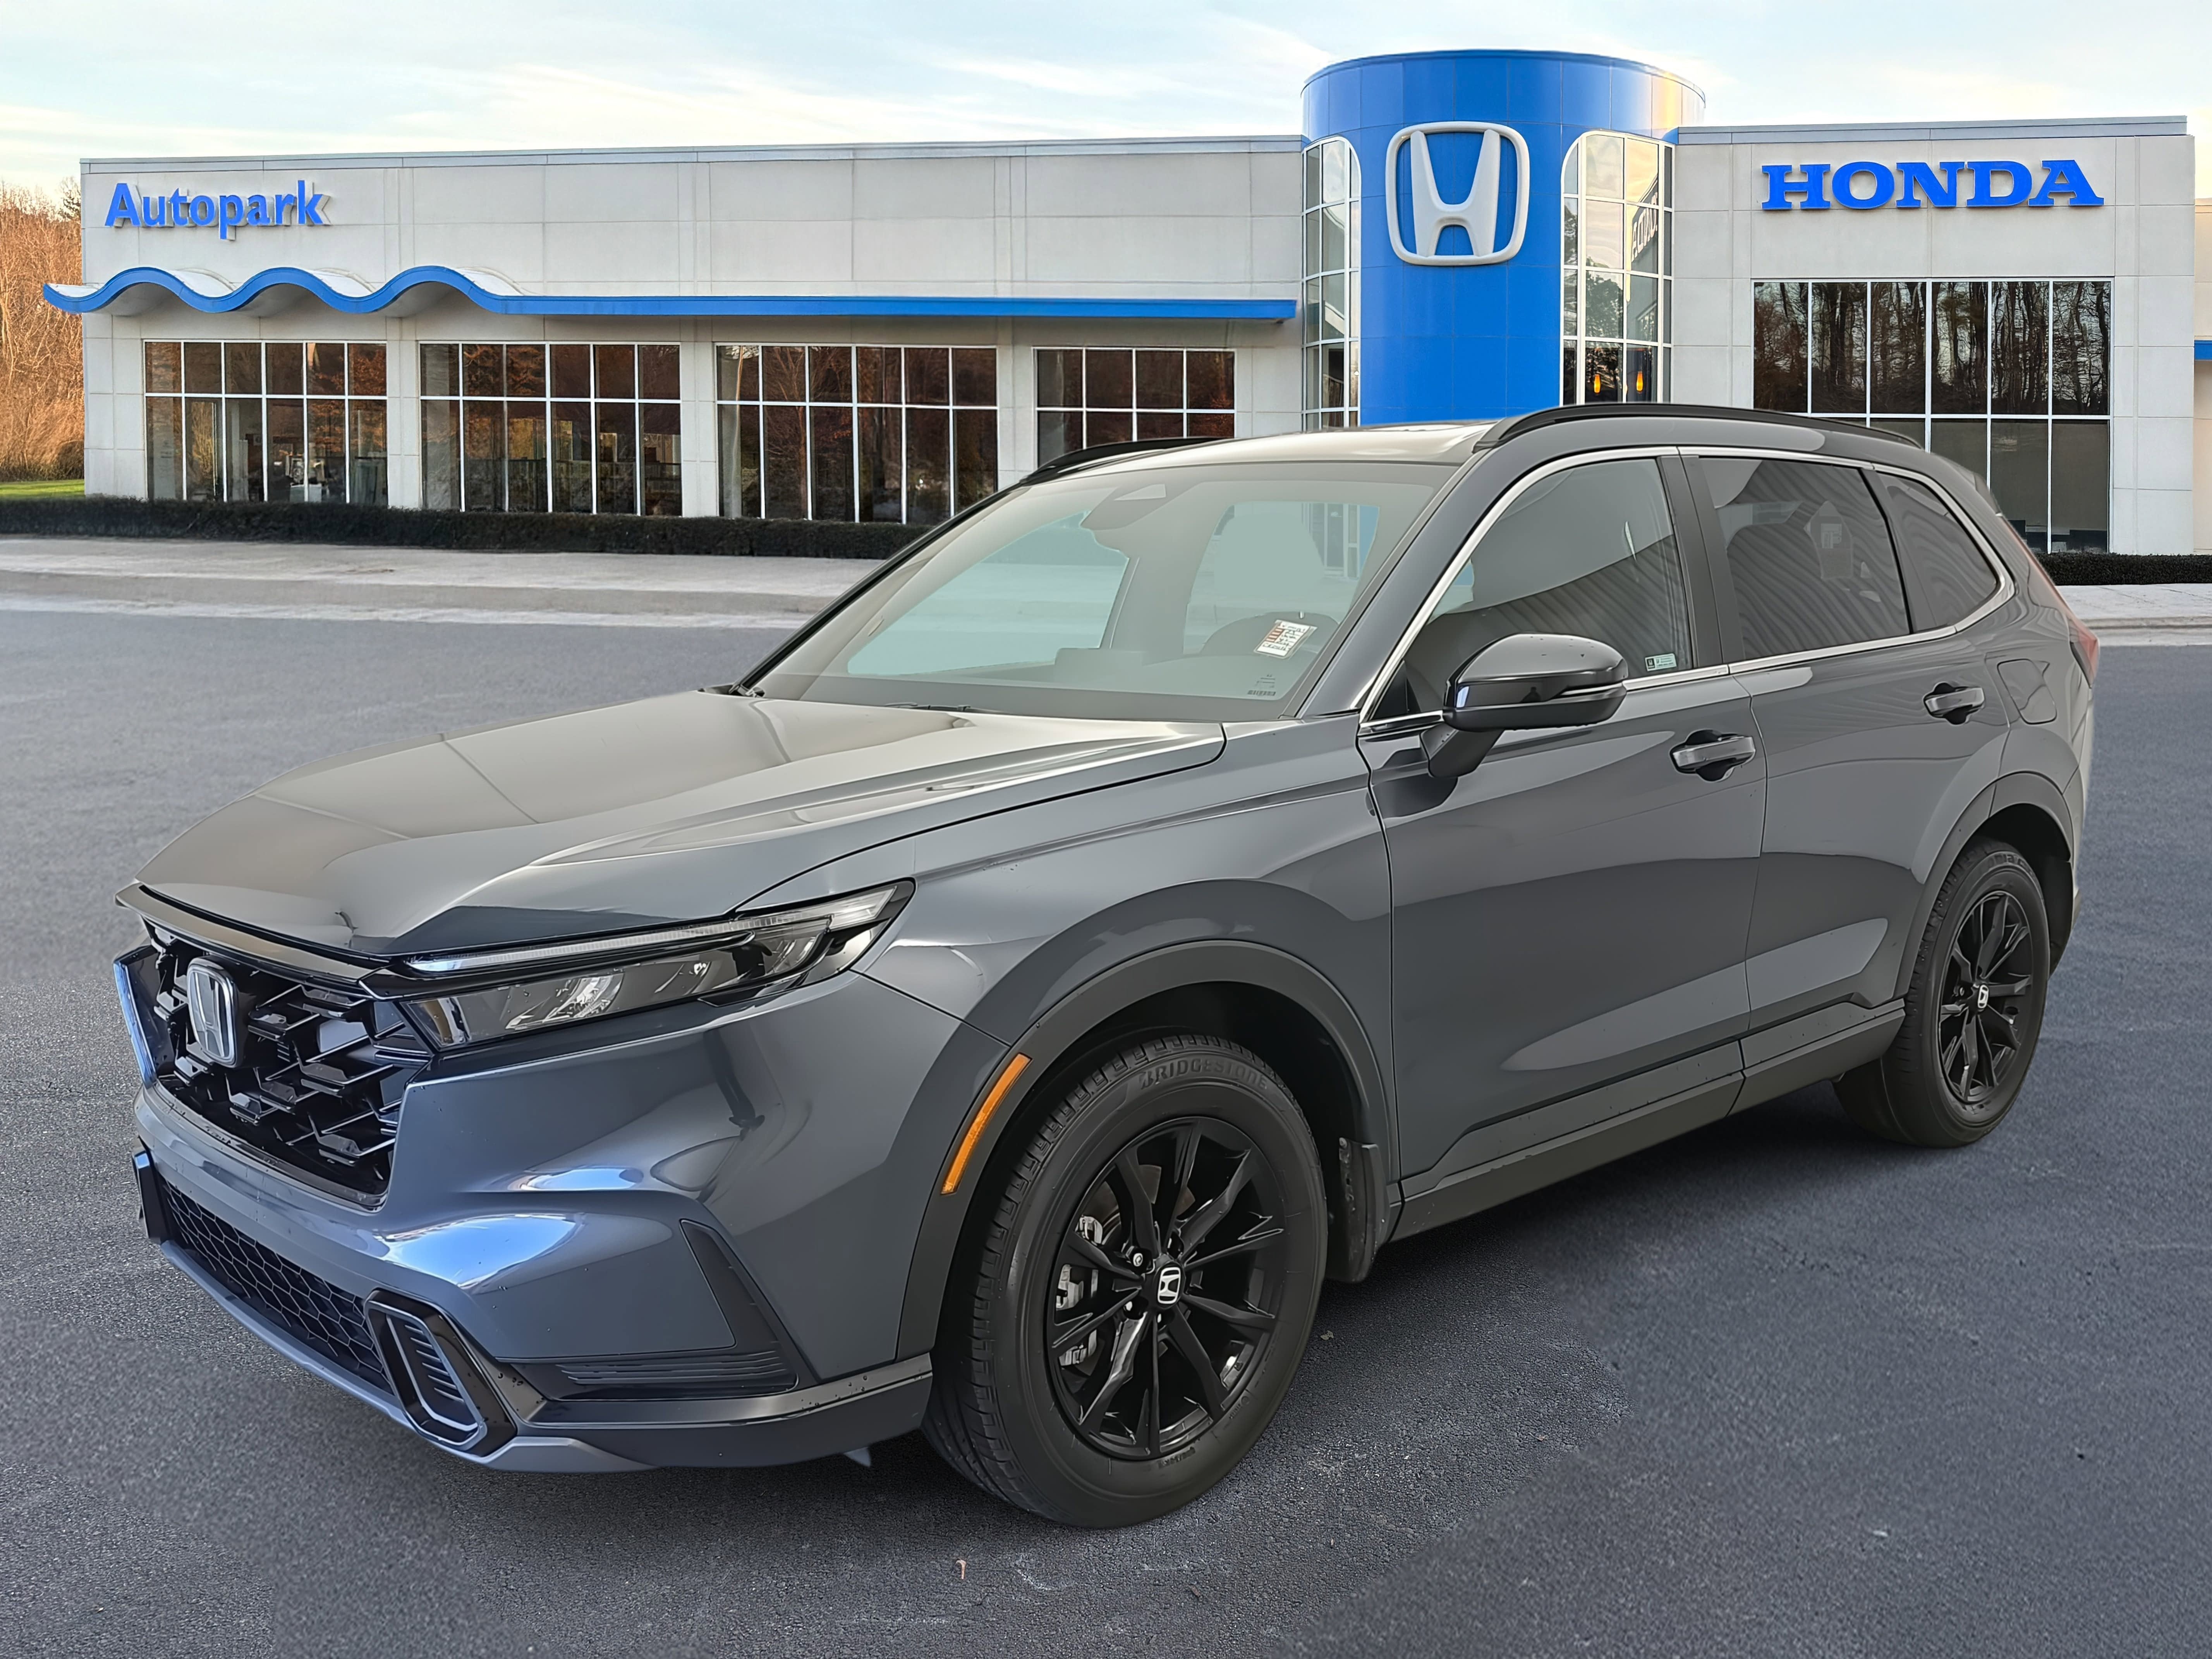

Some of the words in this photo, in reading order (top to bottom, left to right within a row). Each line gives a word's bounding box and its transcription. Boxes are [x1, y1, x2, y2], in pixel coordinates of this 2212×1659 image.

[105, 179, 324, 240] Autopark
[1762, 160, 2104, 210] HONDA
[1139, 1058, 1268, 1090] BRIDGESTONE
